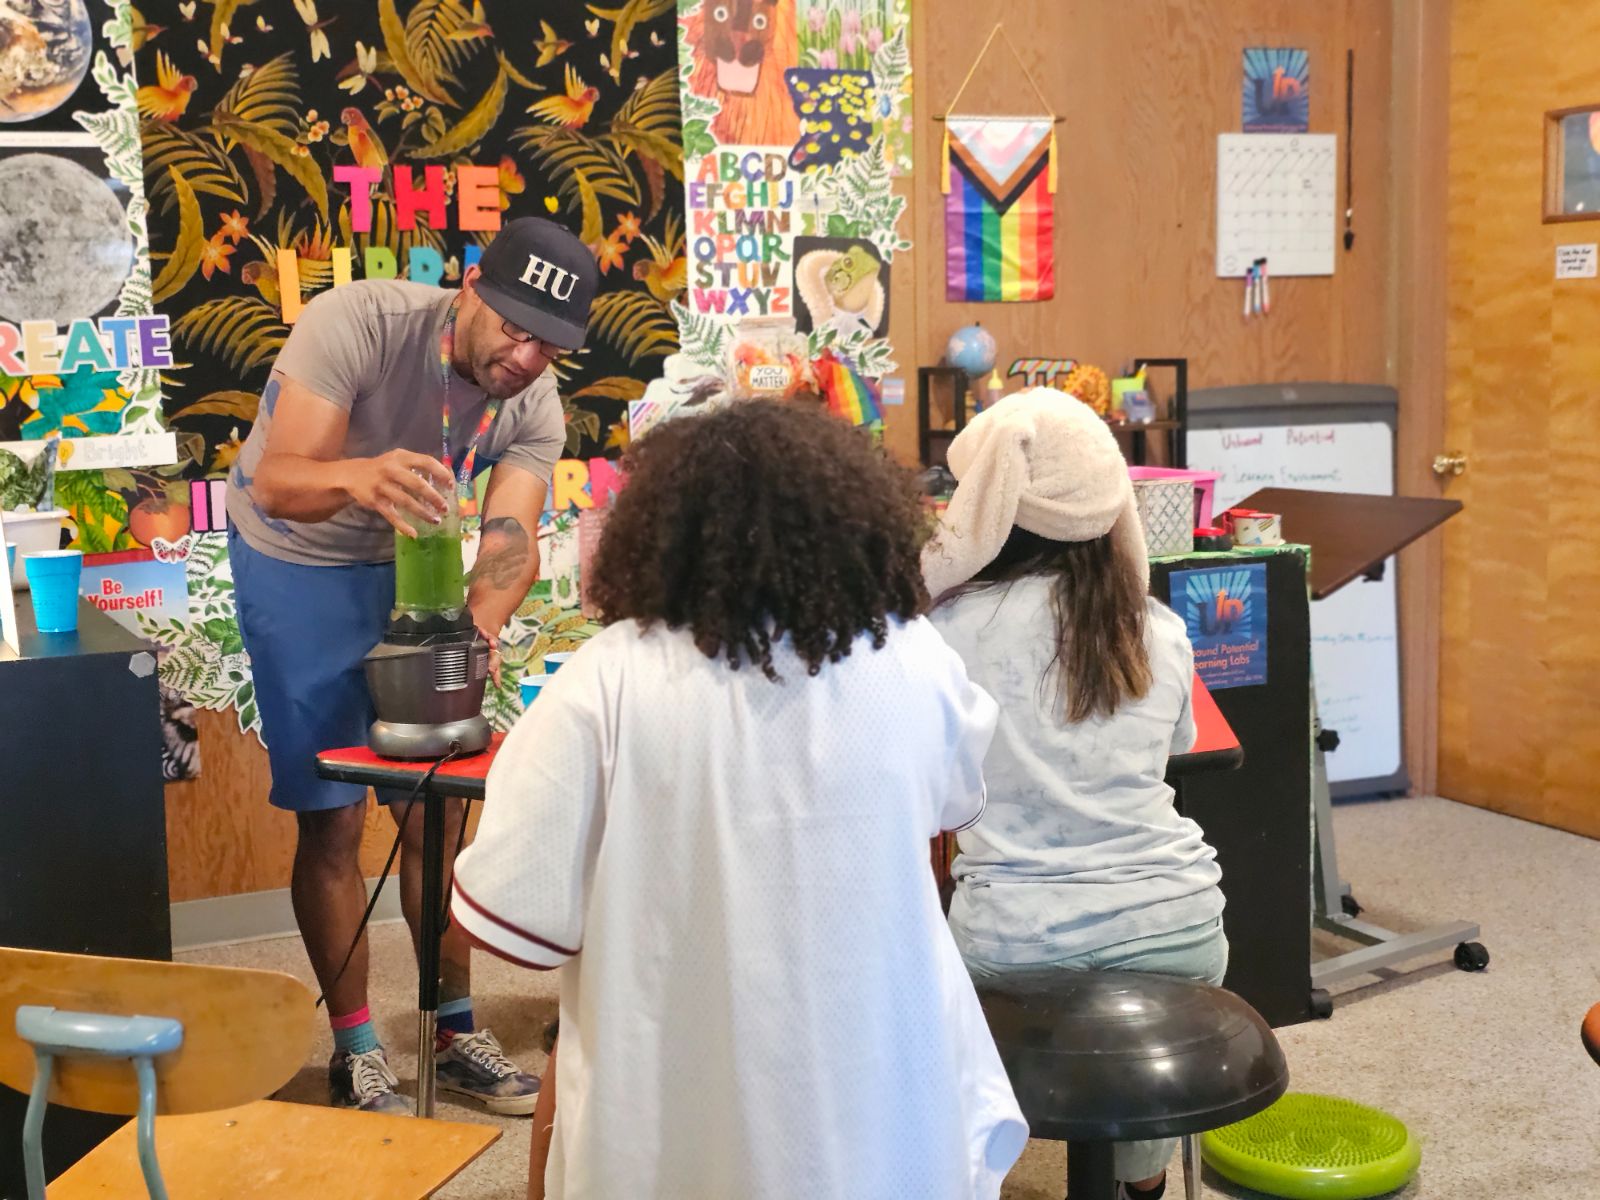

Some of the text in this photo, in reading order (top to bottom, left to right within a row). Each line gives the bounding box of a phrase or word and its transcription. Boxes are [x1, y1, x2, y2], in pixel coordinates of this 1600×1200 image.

[697, 152, 787, 183] ABCD
[333, 165, 502, 232] THE
[689, 181, 793, 210] EFGHIJ
[693, 209, 791, 236] KLMN
[693, 234, 791, 263] OPQR
[518, 254, 580, 301] HU
[694, 262, 781, 289] STUV
[693, 287, 790, 316] WXYZ
[756, 367, 783, 376] YOU
[83, 438, 149, 466] Bright
[88, 589, 163, 612] Yourself!
[102, 579, 123, 596] Be
[1221, 640, 1259, 654] Potential
[1193, 654, 1250, 670] earning Labs
